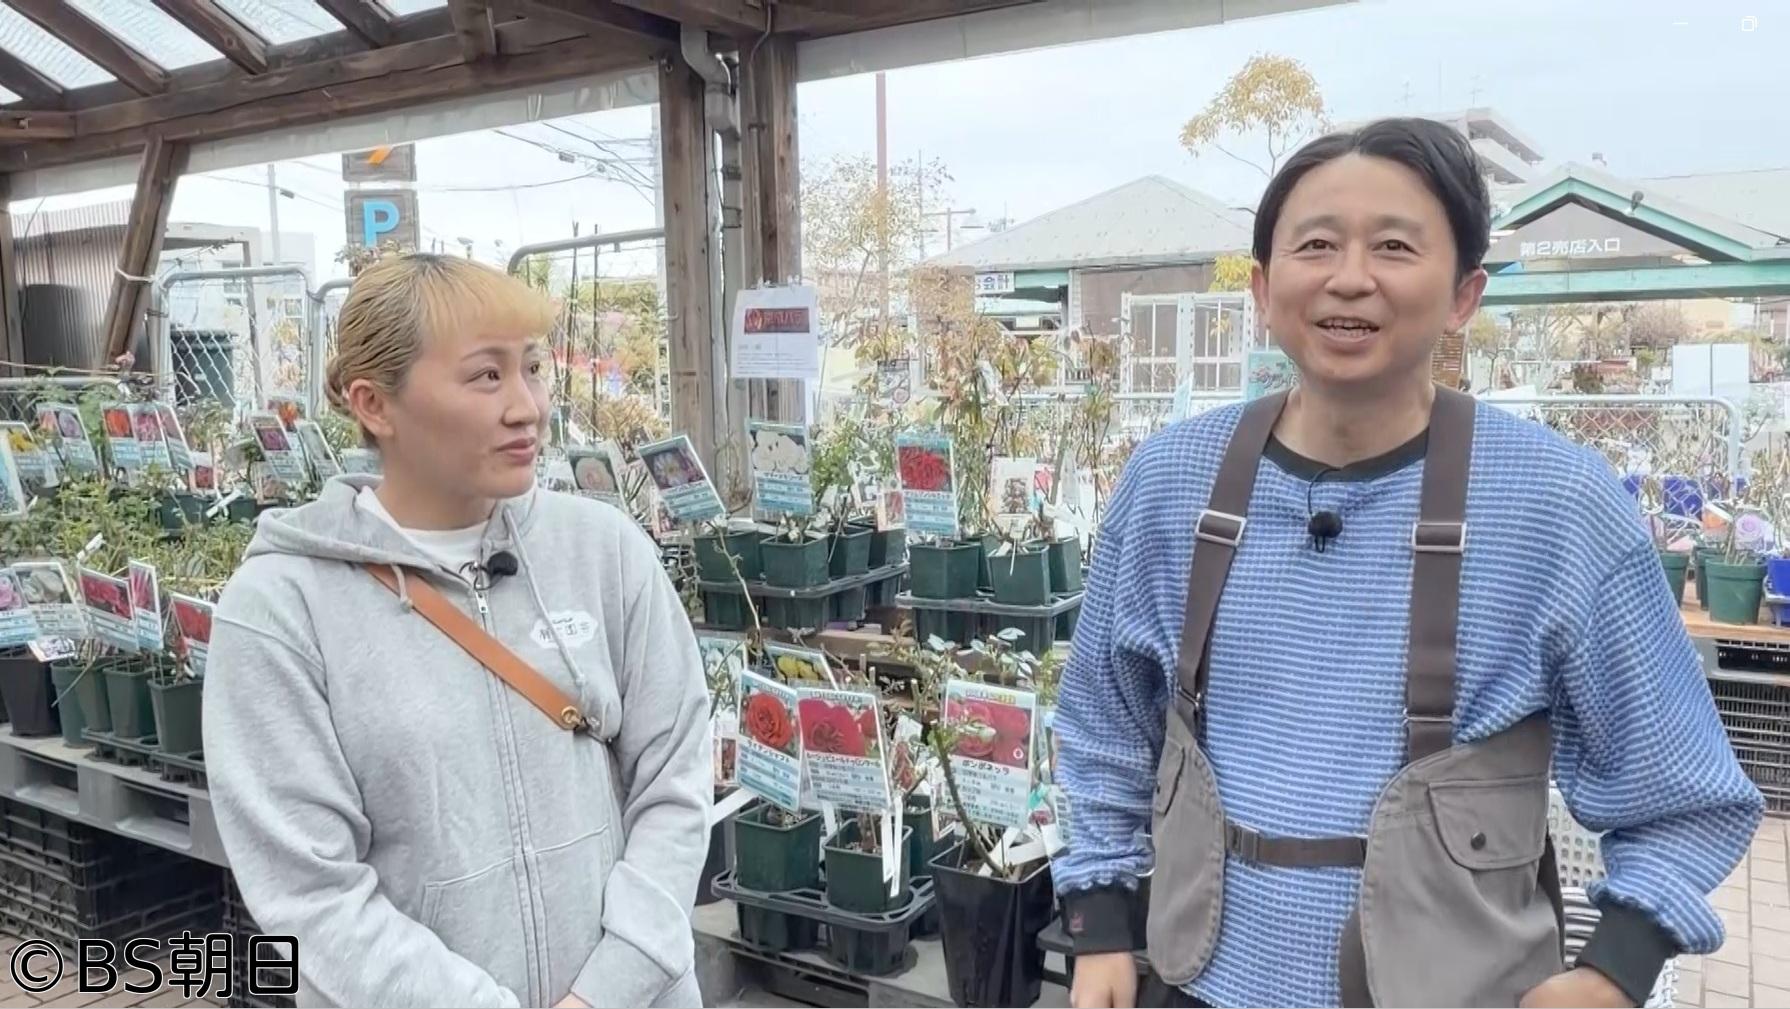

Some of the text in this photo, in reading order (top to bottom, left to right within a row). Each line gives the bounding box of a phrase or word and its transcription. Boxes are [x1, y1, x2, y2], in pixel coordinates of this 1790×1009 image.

[364, 200, 400, 248] P
[1520, 238, 1621, 257] 第2売店入口
